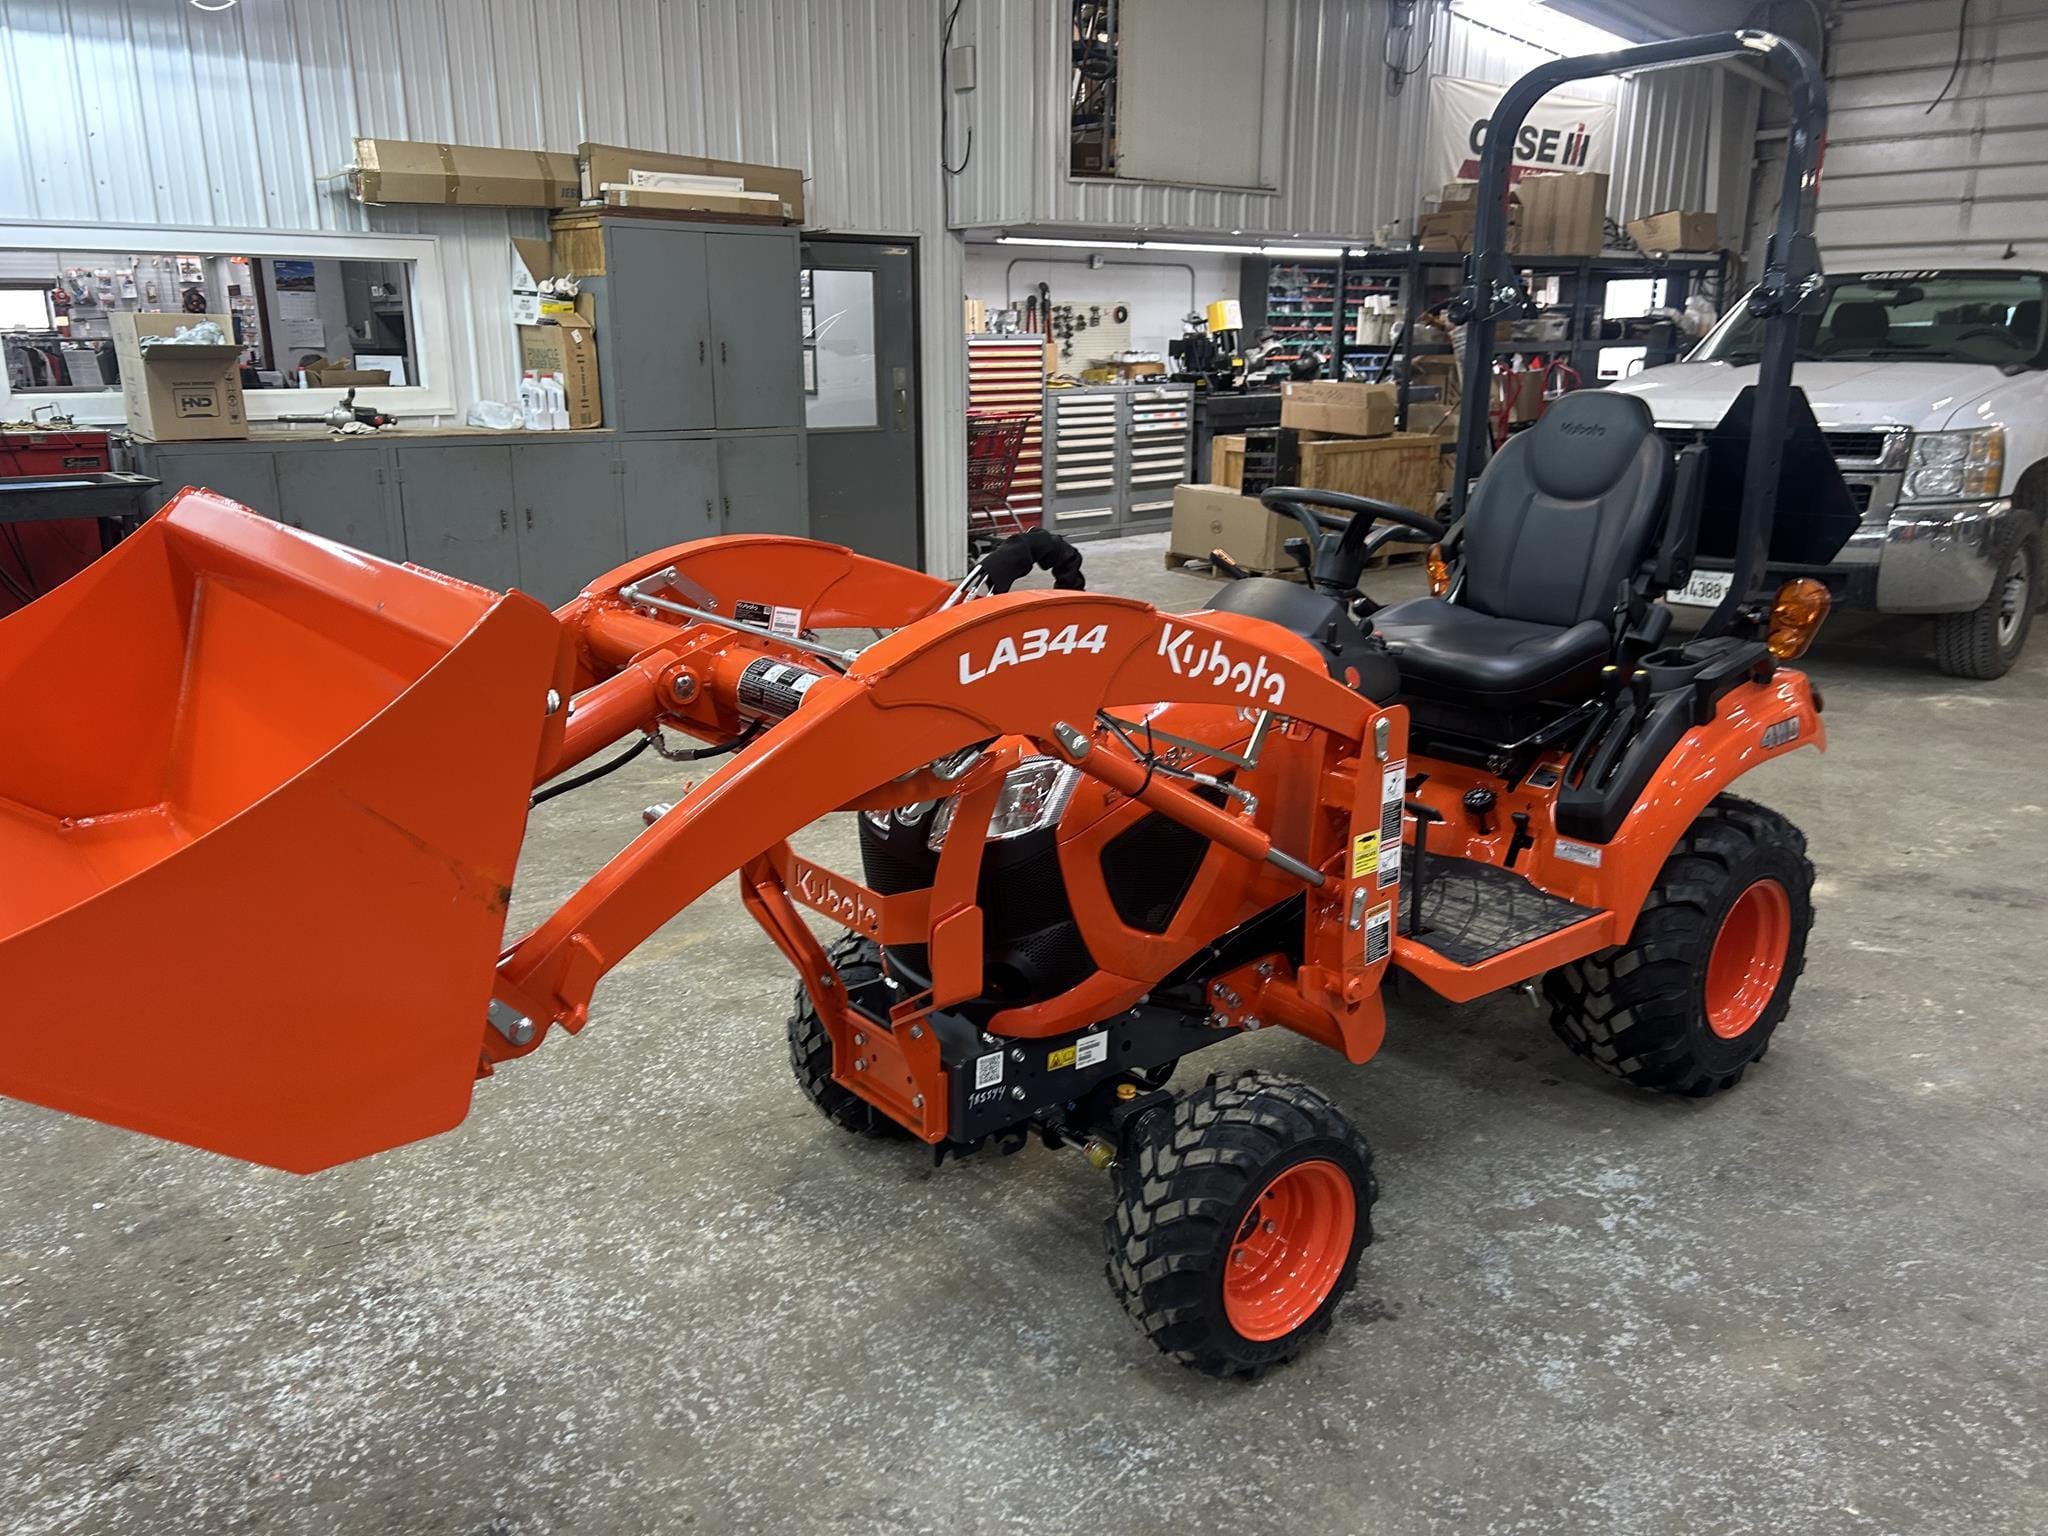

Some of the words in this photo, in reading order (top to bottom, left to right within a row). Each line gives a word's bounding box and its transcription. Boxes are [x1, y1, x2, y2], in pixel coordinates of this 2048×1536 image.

[1469, 118, 1560, 163] CSE
[959, 624, 1108, 685] LA344
[1157, 623, 1286, 705] Kubota
[795, 863, 879, 935] Kubota
